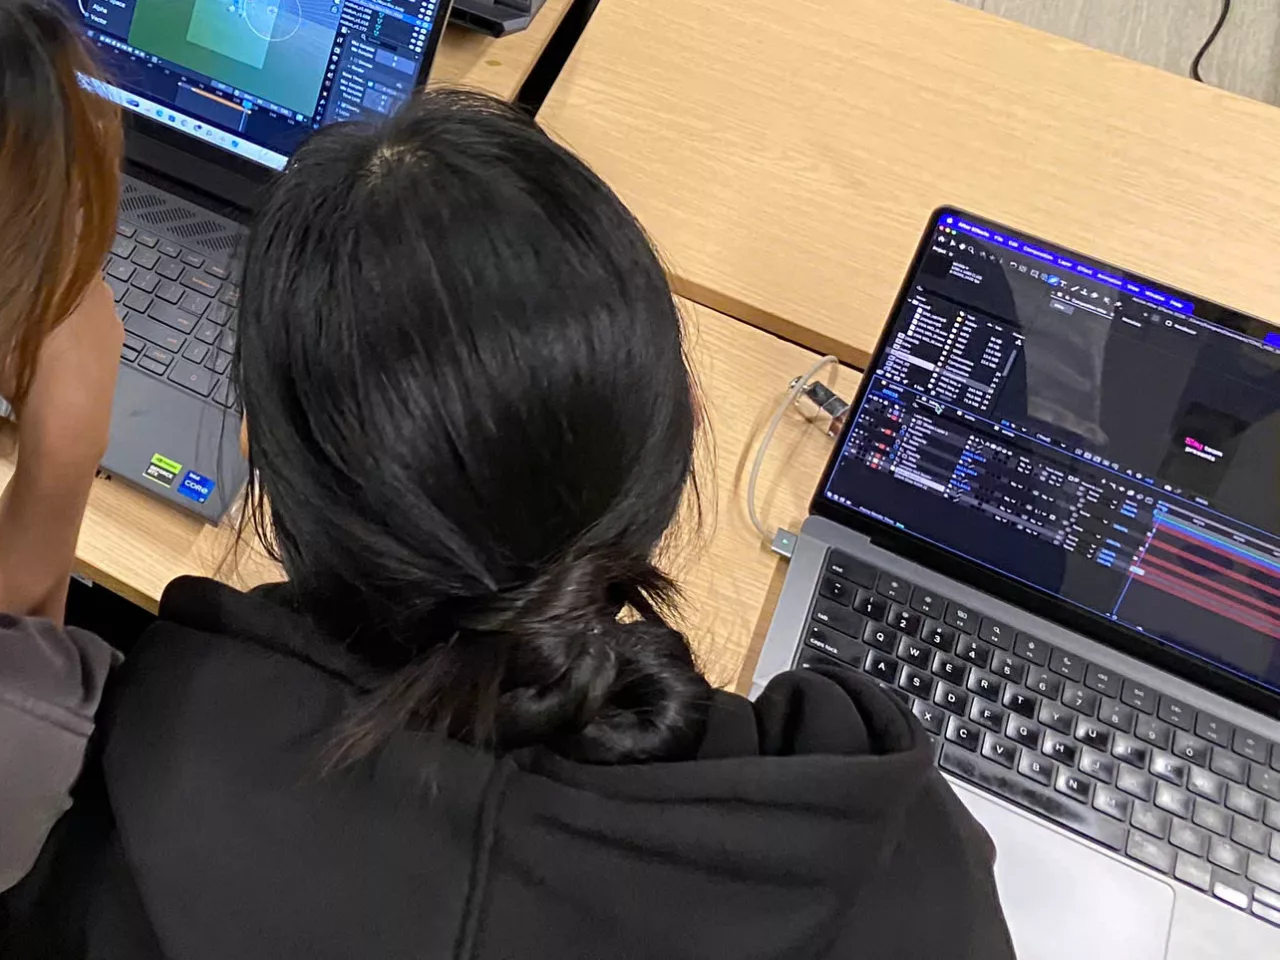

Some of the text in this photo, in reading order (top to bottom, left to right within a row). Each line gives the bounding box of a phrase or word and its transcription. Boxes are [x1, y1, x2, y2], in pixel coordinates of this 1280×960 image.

[876, 632, 884, 642] Q
[909, 647, 920, 657] W
[945, 663, 953, 673] E
[980, 680, 989, 689] R
[1017, 695, 1024, 704] T
[1053, 712, 1060, 720] Y
[1089, 728, 1096, 737] U
[878, 662, 886, 671] A
[912, 677, 921, 686] S
[947, 693, 956, 703] D
[983, 709, 991, 718] F
[1019, 726, 1028, 736] G
[1056, 743, 1064, 753] H
[924, 711, 932, 721] X
[959, 729, 968, 738] C
[996, 744, 1004, 754] V
[1032, 762, 1040, 771] B
[1070, 779, 1078, 790] N
